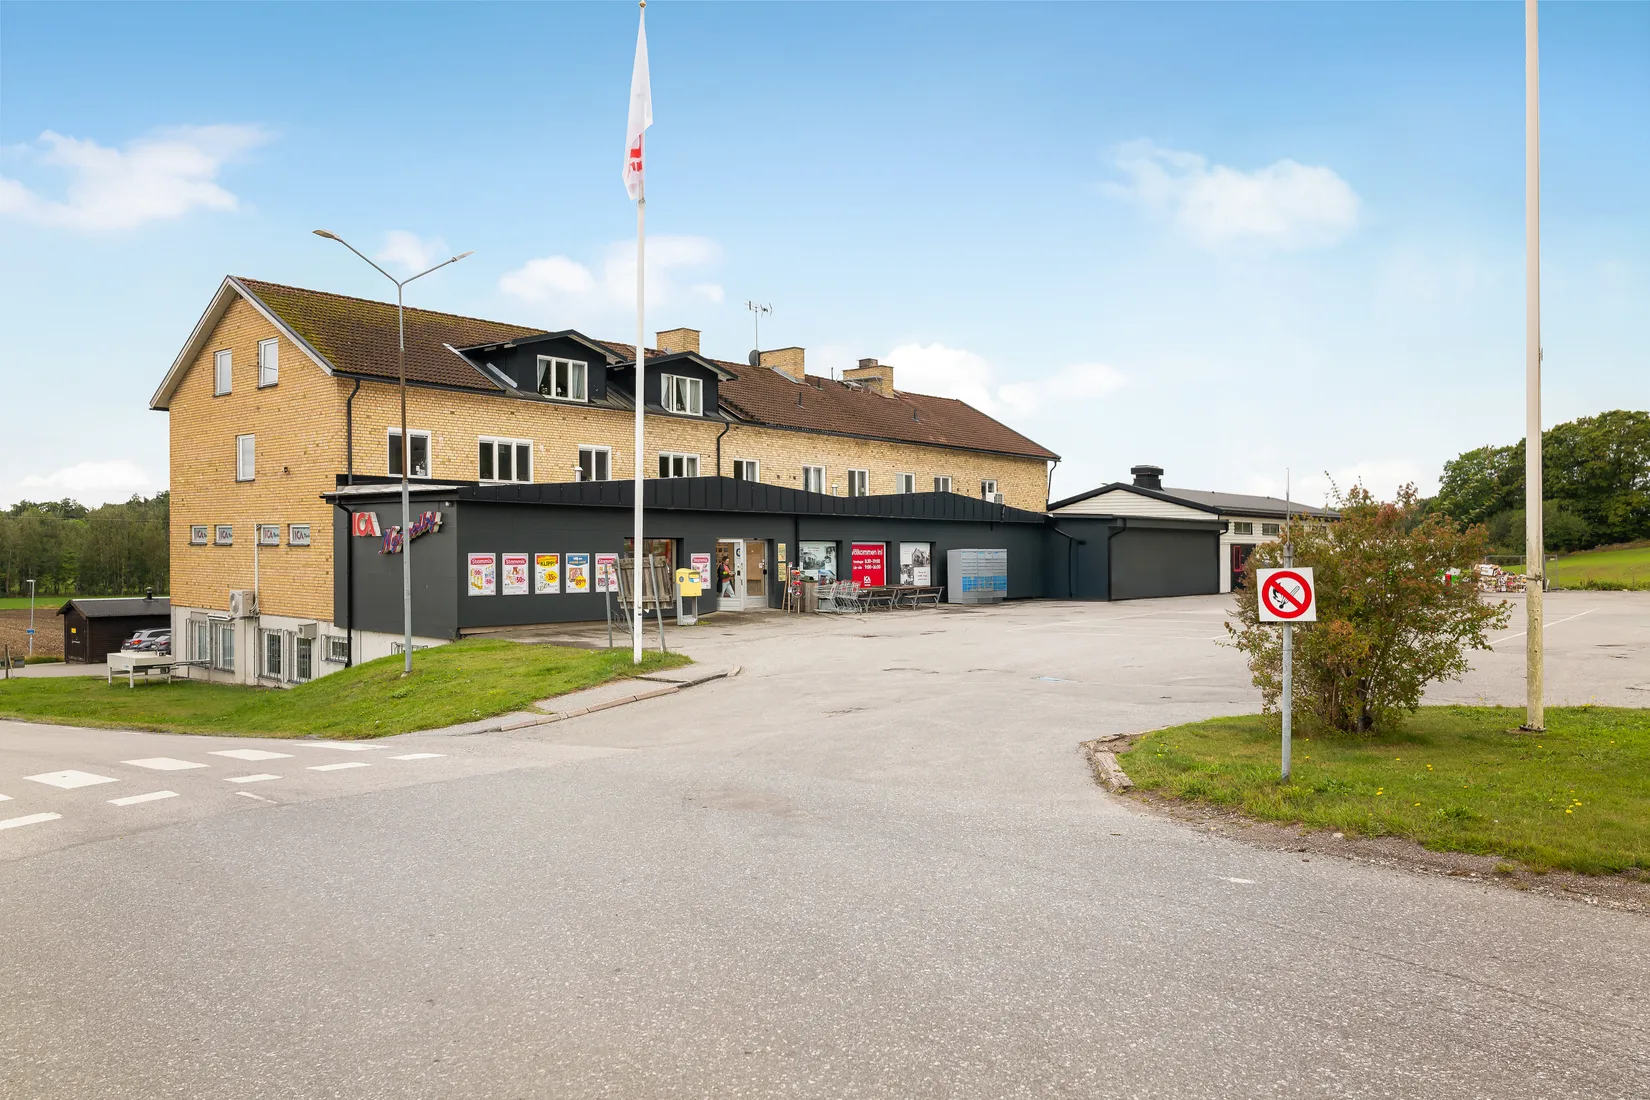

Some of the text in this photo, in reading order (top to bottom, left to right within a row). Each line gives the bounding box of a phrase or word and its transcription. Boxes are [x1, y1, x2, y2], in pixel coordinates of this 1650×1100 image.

[352, 512, 379, 536] ICA
[264, 530, 273, 538] ICA
[294, 530, 304, 539] ICA
